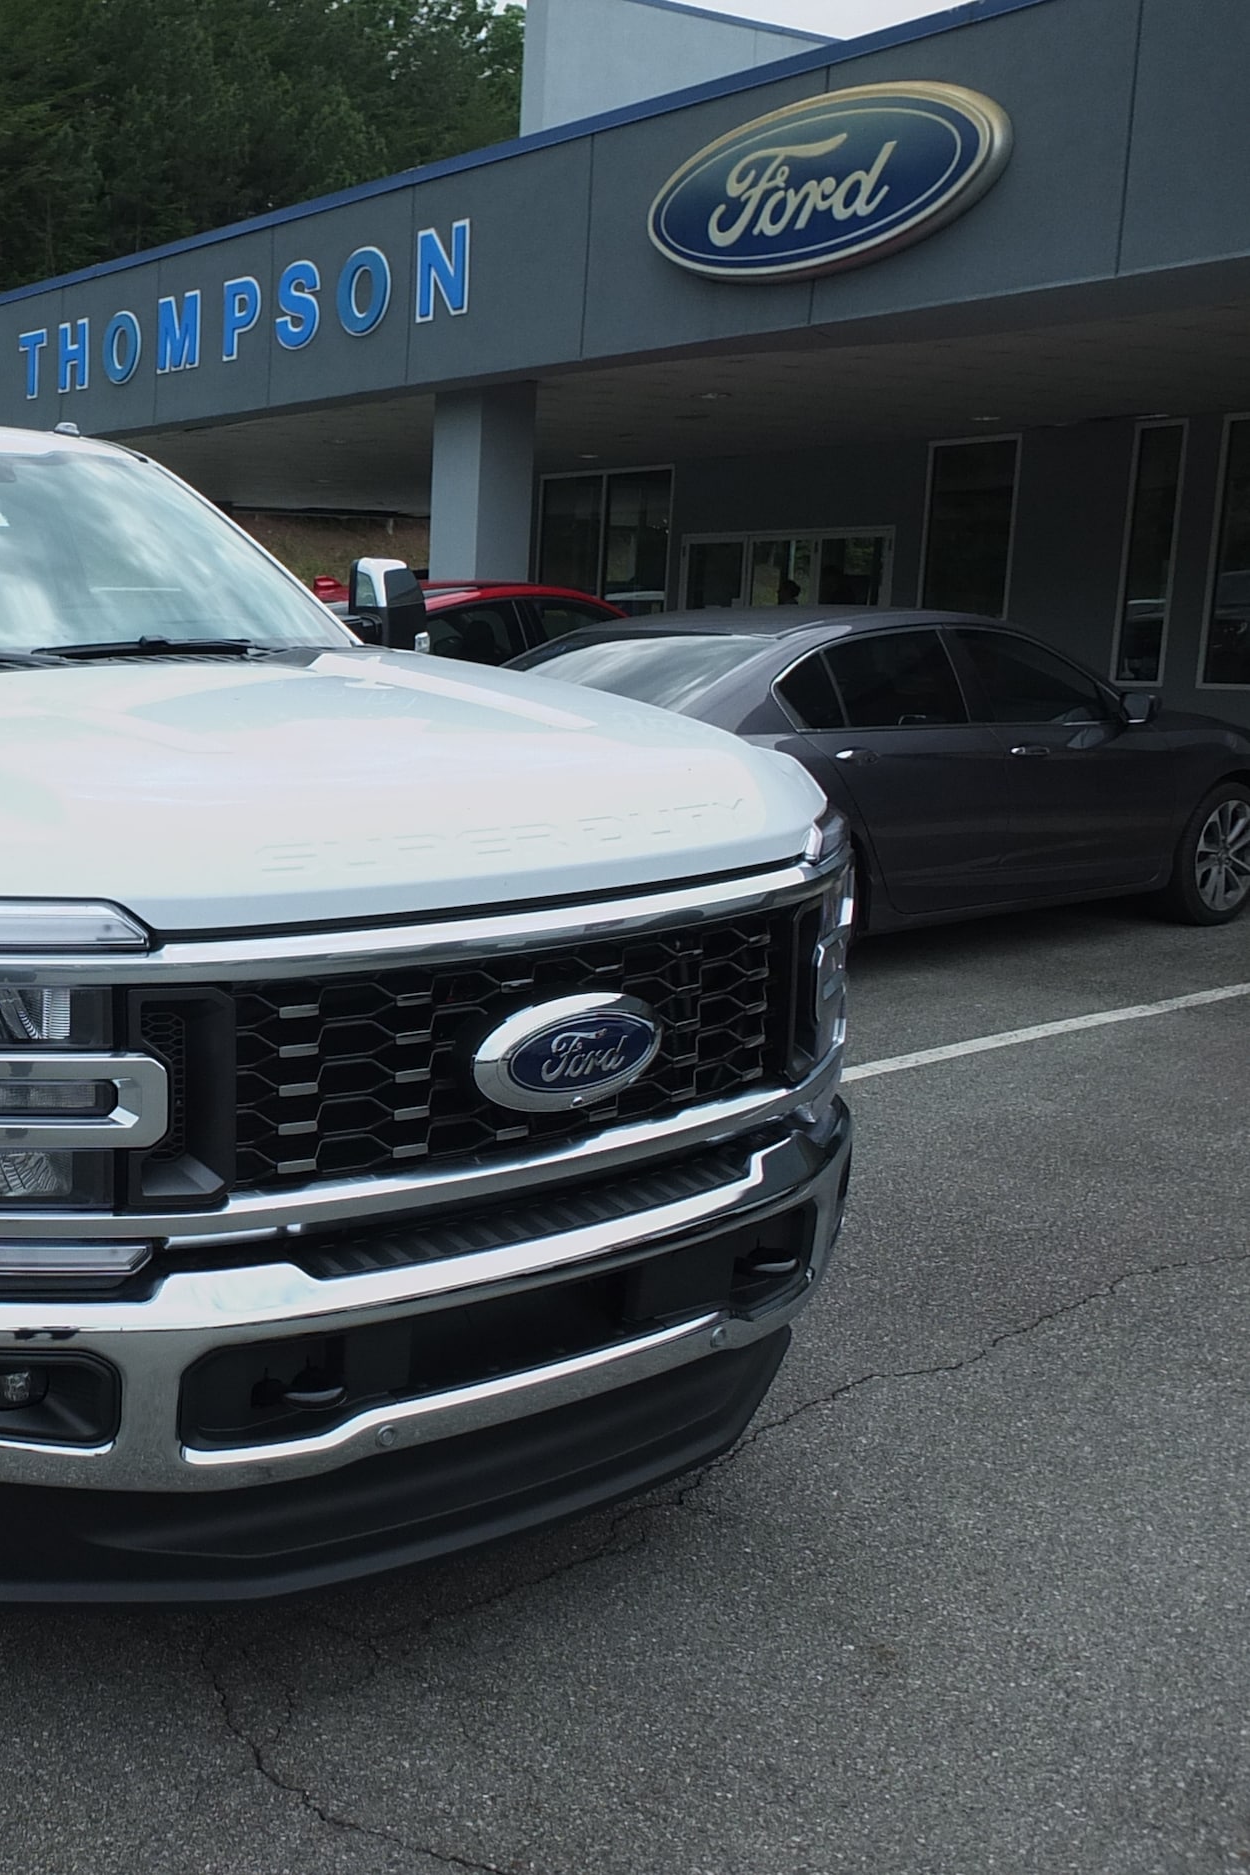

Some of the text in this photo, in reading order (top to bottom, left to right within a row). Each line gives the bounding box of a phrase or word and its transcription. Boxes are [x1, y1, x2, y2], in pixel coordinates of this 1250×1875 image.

[707, 132, 898, 248] Ford
[18, 218, 471, 400] THOMPSON
[540, 1027, 628, 1083] Ford
